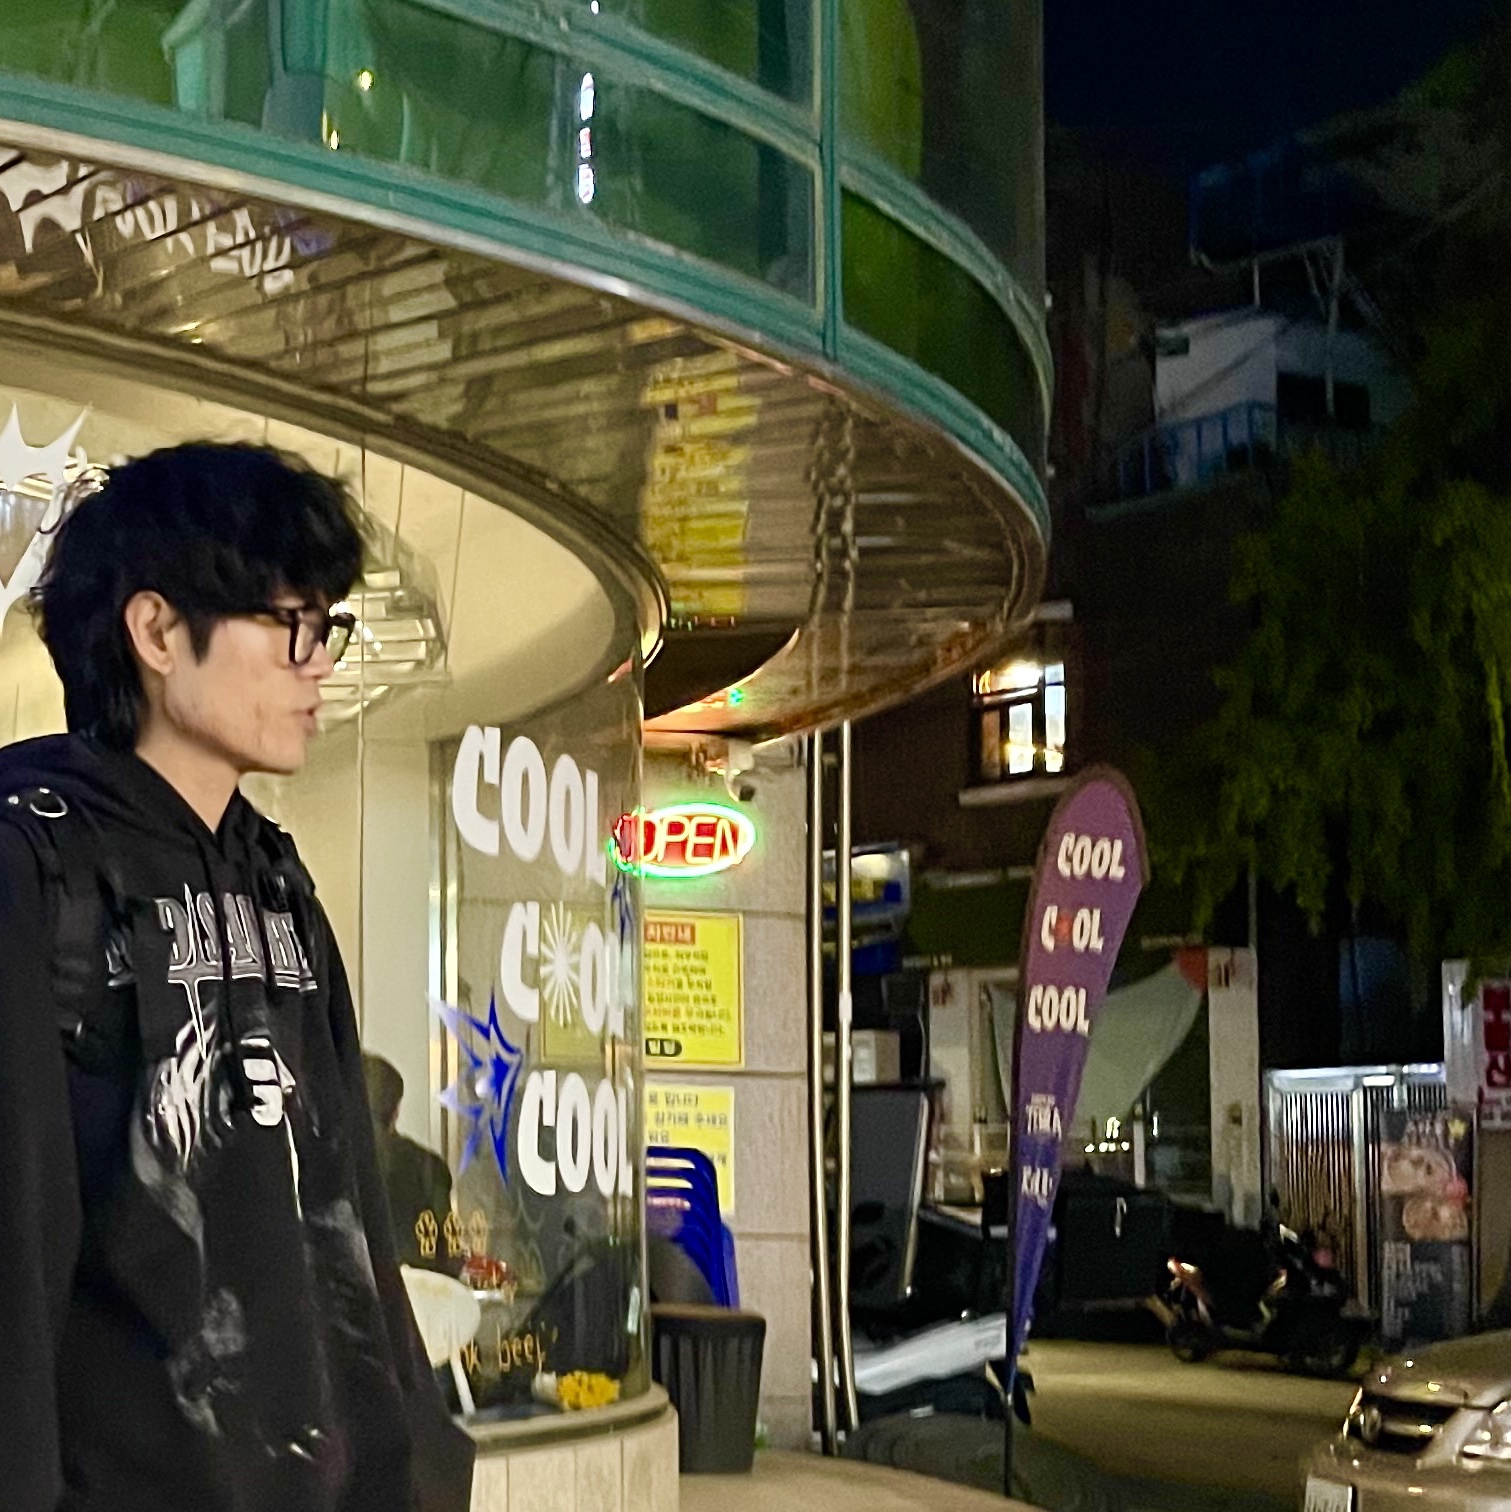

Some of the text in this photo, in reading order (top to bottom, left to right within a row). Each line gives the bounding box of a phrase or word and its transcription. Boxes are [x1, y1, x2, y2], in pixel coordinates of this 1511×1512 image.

[452, 724, 606, 888] COOL
[615, 814, 742, 865] OPEN
[1057, 831, 1127, 882] COOL
[1027, 983, 1090, 1037] COOL
[517, 1069, 634, 1198] COOL
